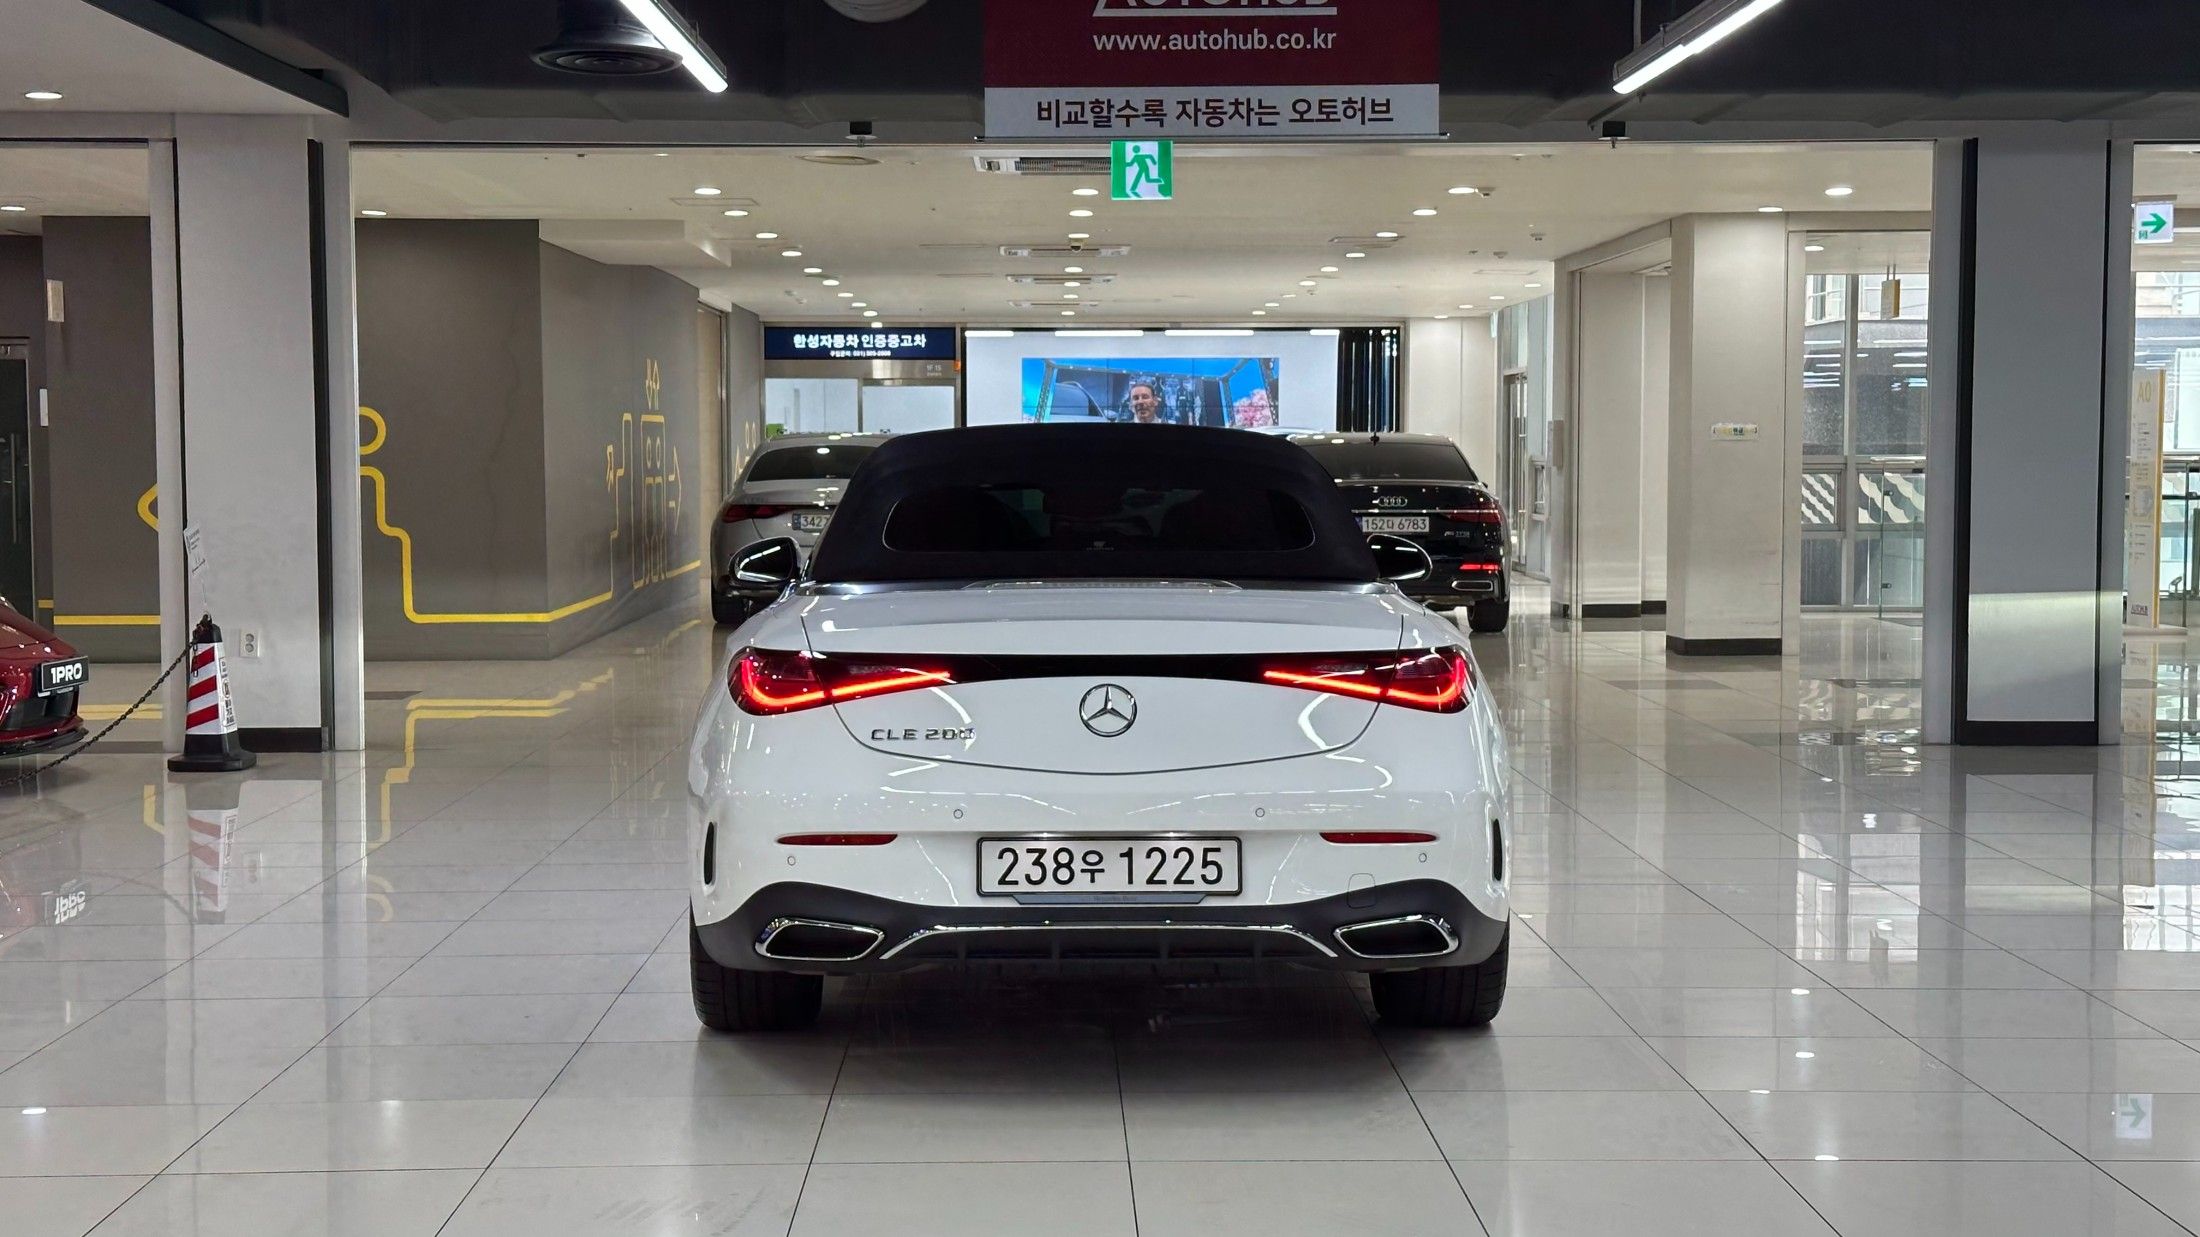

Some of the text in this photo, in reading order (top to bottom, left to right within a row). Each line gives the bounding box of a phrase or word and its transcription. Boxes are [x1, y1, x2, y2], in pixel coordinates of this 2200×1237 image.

[1093, 28, 1337, 50] www.autohub.co.kr
[1037, 97, 1394, 128] 비교할수록 자동차는 오토허브
[1397, 518, 1427, 530] 6783
[50, 662, 83, 684] 1PRO
[871, 729, 918, 740] CLE
[997, 847, 1223, 885] 238우 1225
